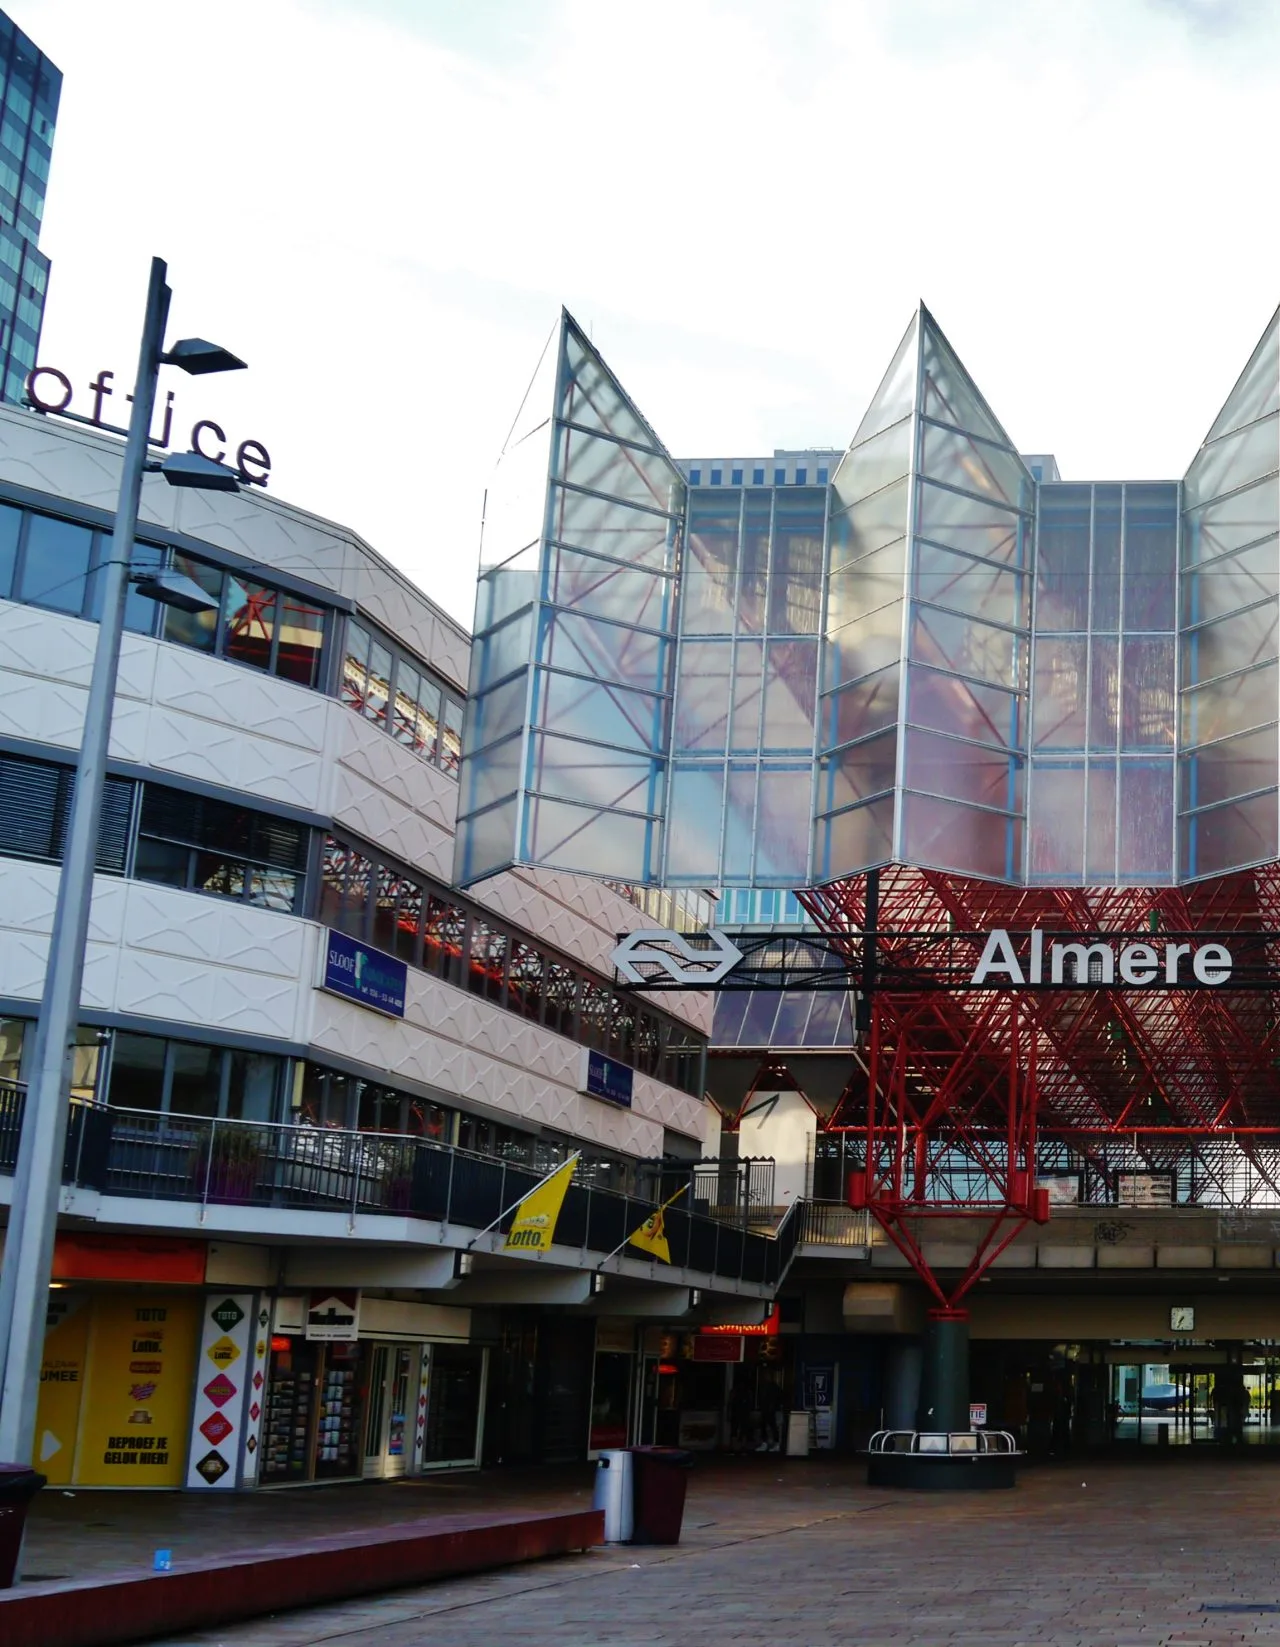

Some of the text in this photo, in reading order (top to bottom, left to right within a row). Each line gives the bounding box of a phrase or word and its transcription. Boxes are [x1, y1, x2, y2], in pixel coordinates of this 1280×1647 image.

[25, 366, 272, 488] ofice
[969, 928, 1233, 985] Almere
[506, 1229, 545, 1248] Lotto.
[217, 1311, 237, 1321] TOTO
[108, 1437, 154, 1449] BEPROEF
